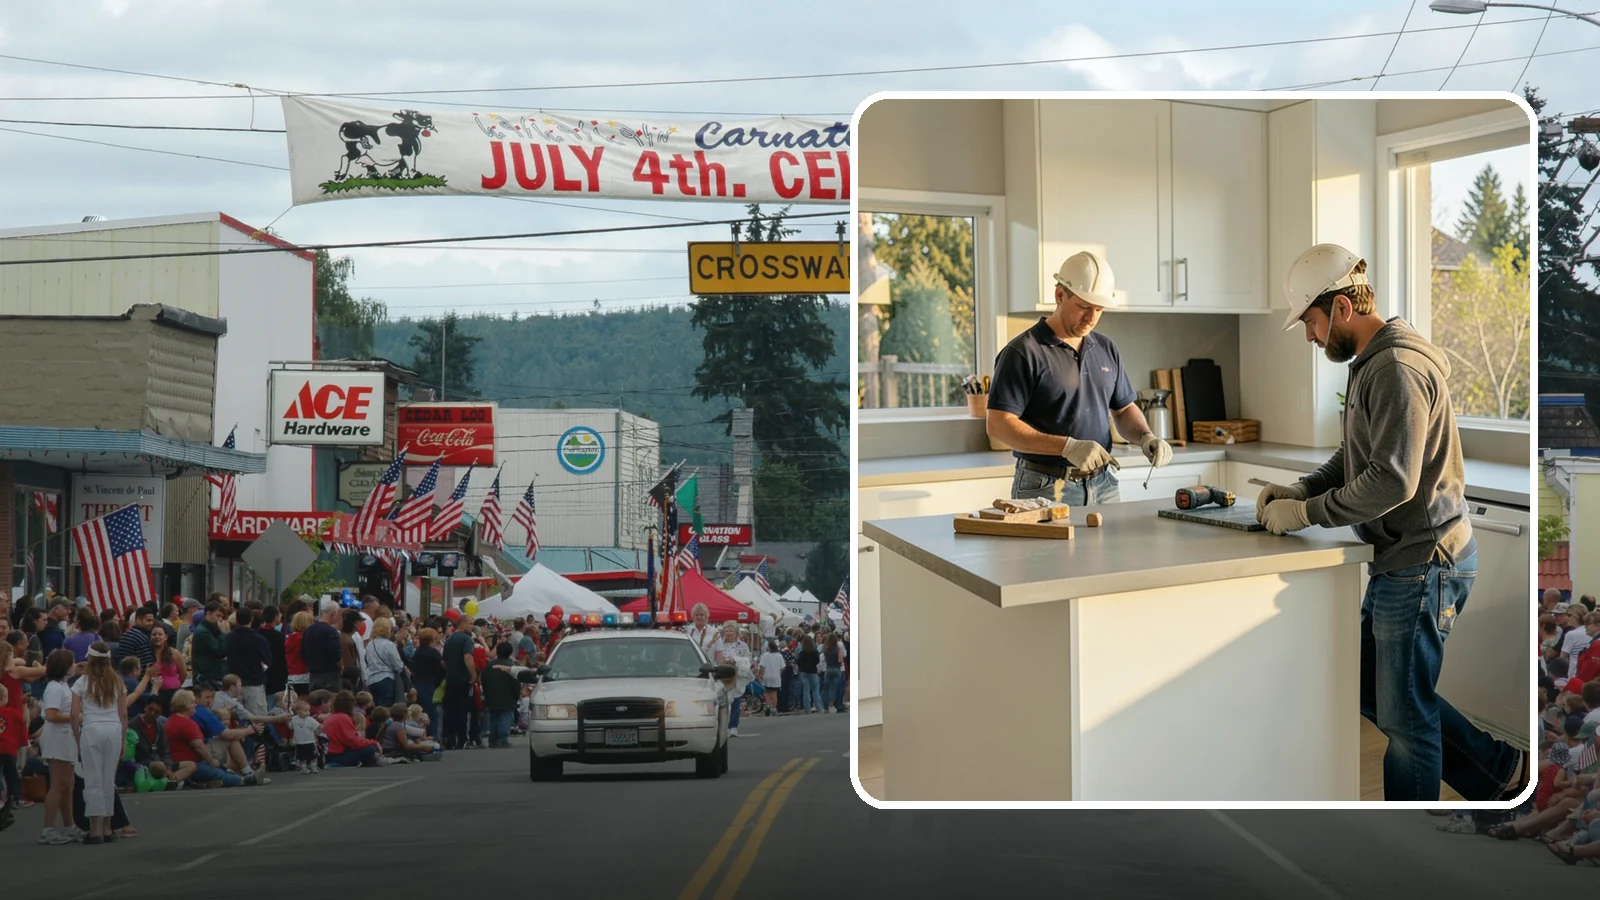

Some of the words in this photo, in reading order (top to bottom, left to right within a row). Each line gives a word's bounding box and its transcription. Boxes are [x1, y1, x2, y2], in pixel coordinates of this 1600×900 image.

[694, 121, 850, 150] Carnat
[481, 140, 605, 193] JULY
[632, 149, 747, 198] 4th.
[697, 254, 850, 280] CROSSWA
[282, 379, 374, 420] ACE
[405, 409, 452, 421] CEDAR
[283, 420, 371, 436] Hardware
[416, 428, 477, 447] Coca-Cola
[83, 486, 93, 494] St.
[95, 485, 124, 495] Vincent
[126, 485, 136, 494] de
[137, 485, 155, 495] Paul
[212, 515, 330, 535] HARDARE
[688, 526, 741, 535] CRNATION
[699, 535, 730, 543] GLASS
